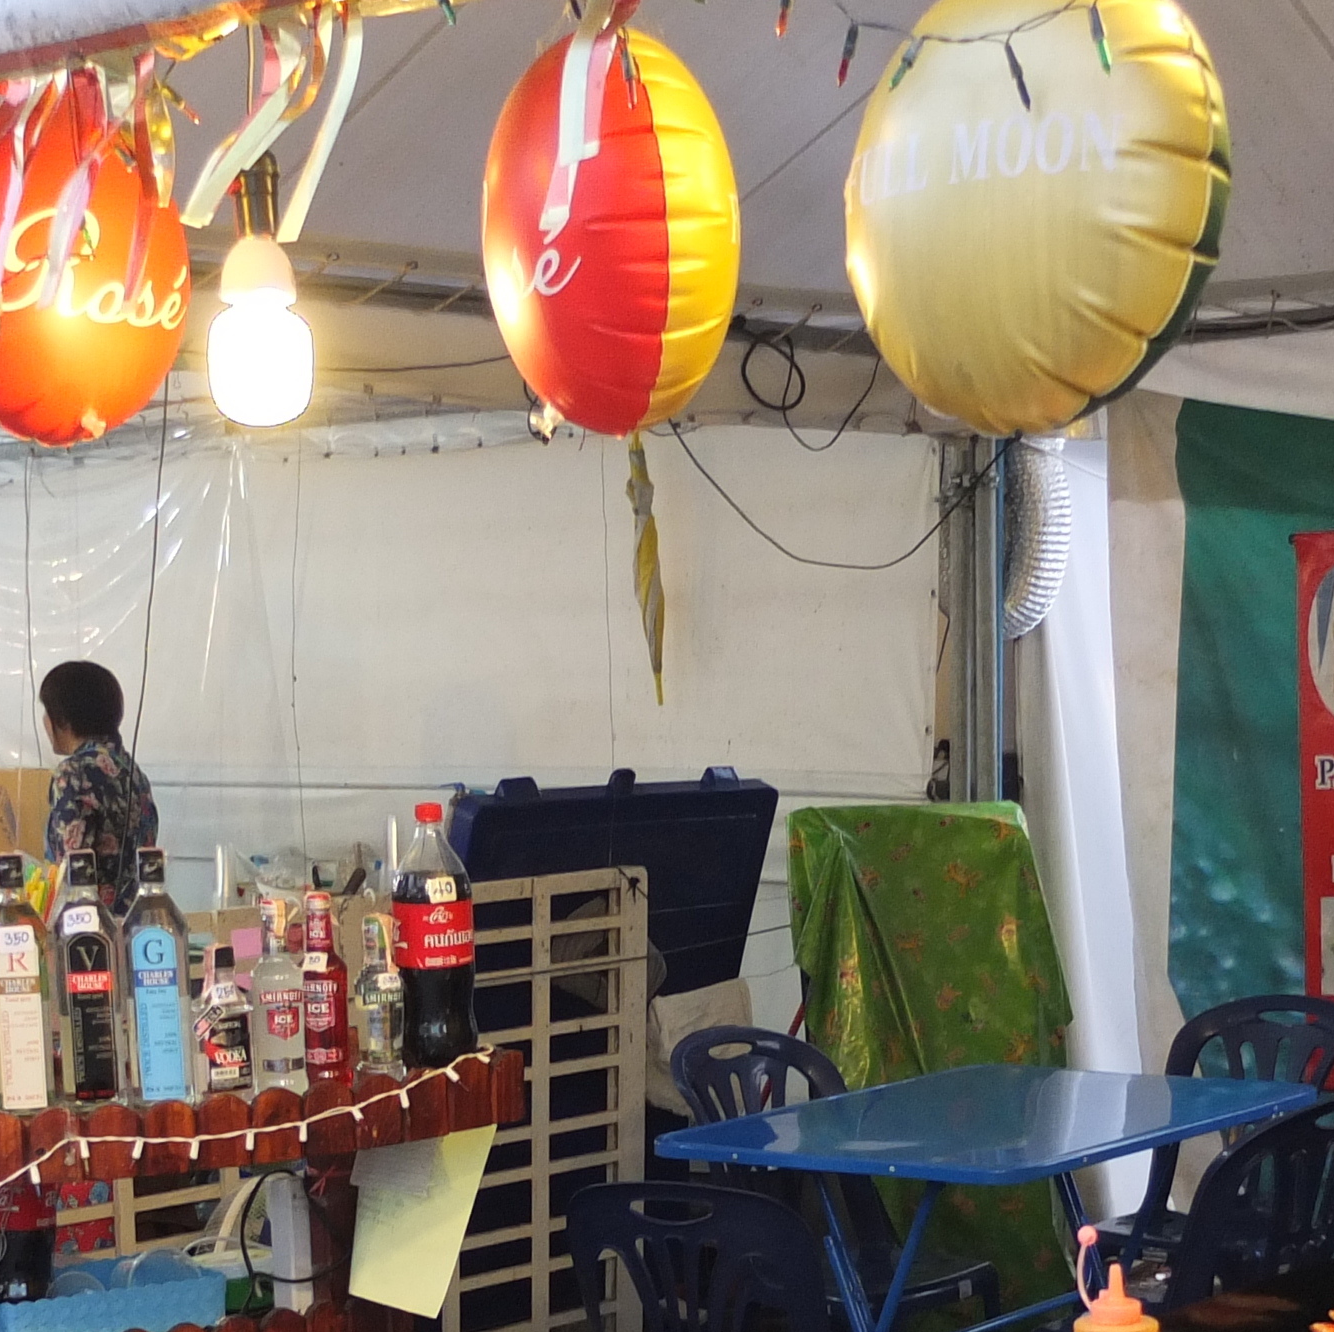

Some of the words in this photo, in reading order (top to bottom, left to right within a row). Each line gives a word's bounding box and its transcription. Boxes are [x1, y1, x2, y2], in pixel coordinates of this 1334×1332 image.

[948, 111, 1125, 185] MOON
[76, 945, 100, 972] V
[143, 939, 165, 965] G
[274, 1014, 294, 1025] ICE
[307, 1003, 330, 1014] ICE
